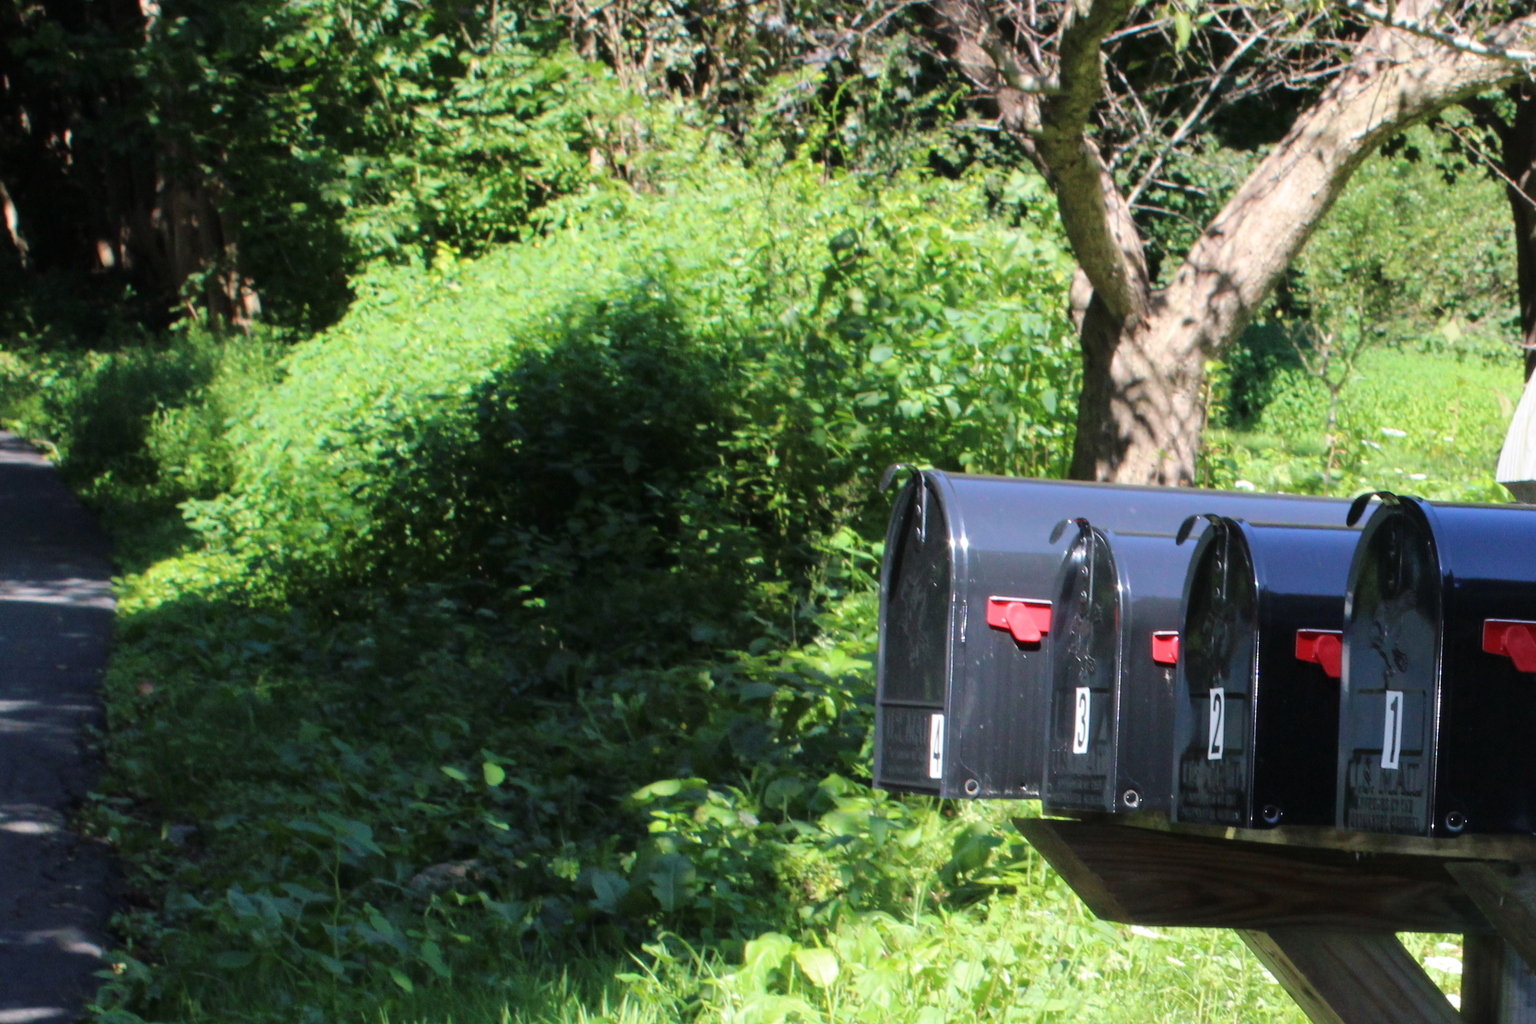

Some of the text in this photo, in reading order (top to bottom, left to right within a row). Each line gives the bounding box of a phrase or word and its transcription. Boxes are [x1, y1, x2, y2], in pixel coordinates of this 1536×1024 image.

[932, 719, 941, 773] 4
[1077, 692, 1088, 748] 3
[1211, 692, 1223, 755] 2
[1389, 695, 1399, 764] 1
